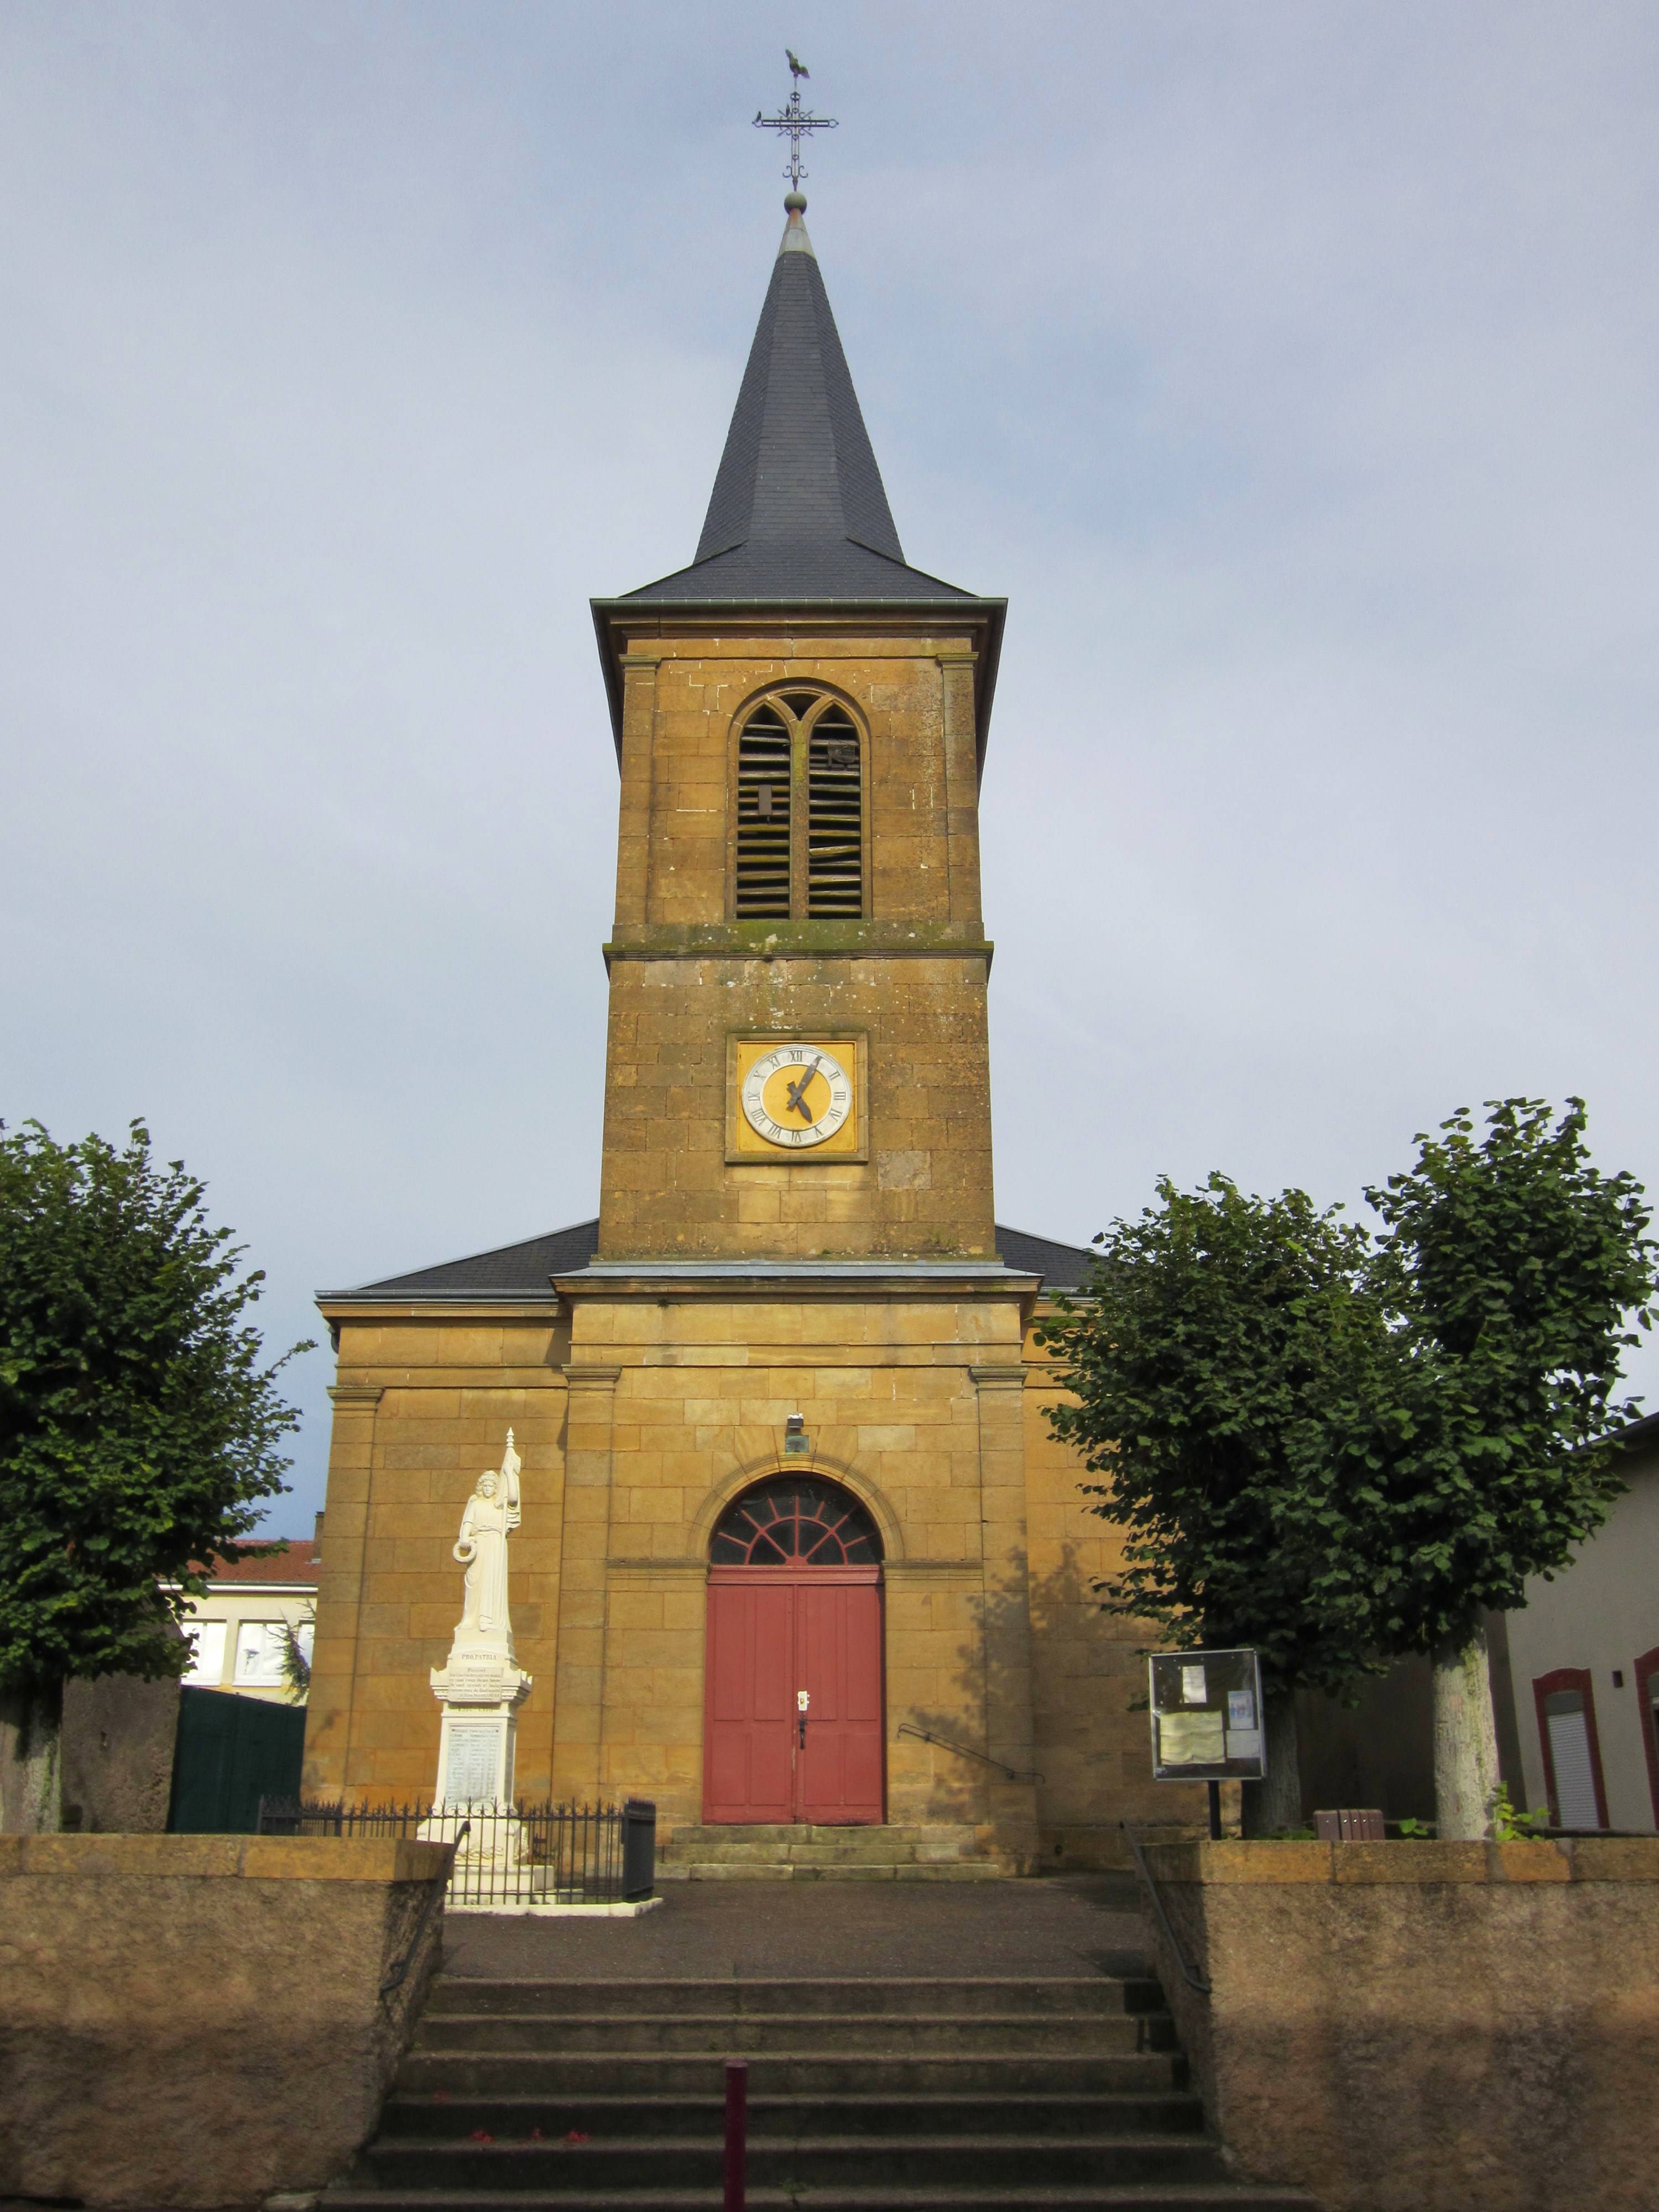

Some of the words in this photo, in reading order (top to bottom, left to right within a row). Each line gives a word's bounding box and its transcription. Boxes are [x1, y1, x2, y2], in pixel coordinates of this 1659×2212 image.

[790, 1051, 802, 1062] XII
[768, 1055, 780, 1070] XI
[753, 1070, 766, 1081] X
[830, 1071, 841, 1080] II
[834, 1092, 845, 1100] III
[829, 1108, 842, 1122] IV
[814, 1126, 823, 1138] V
